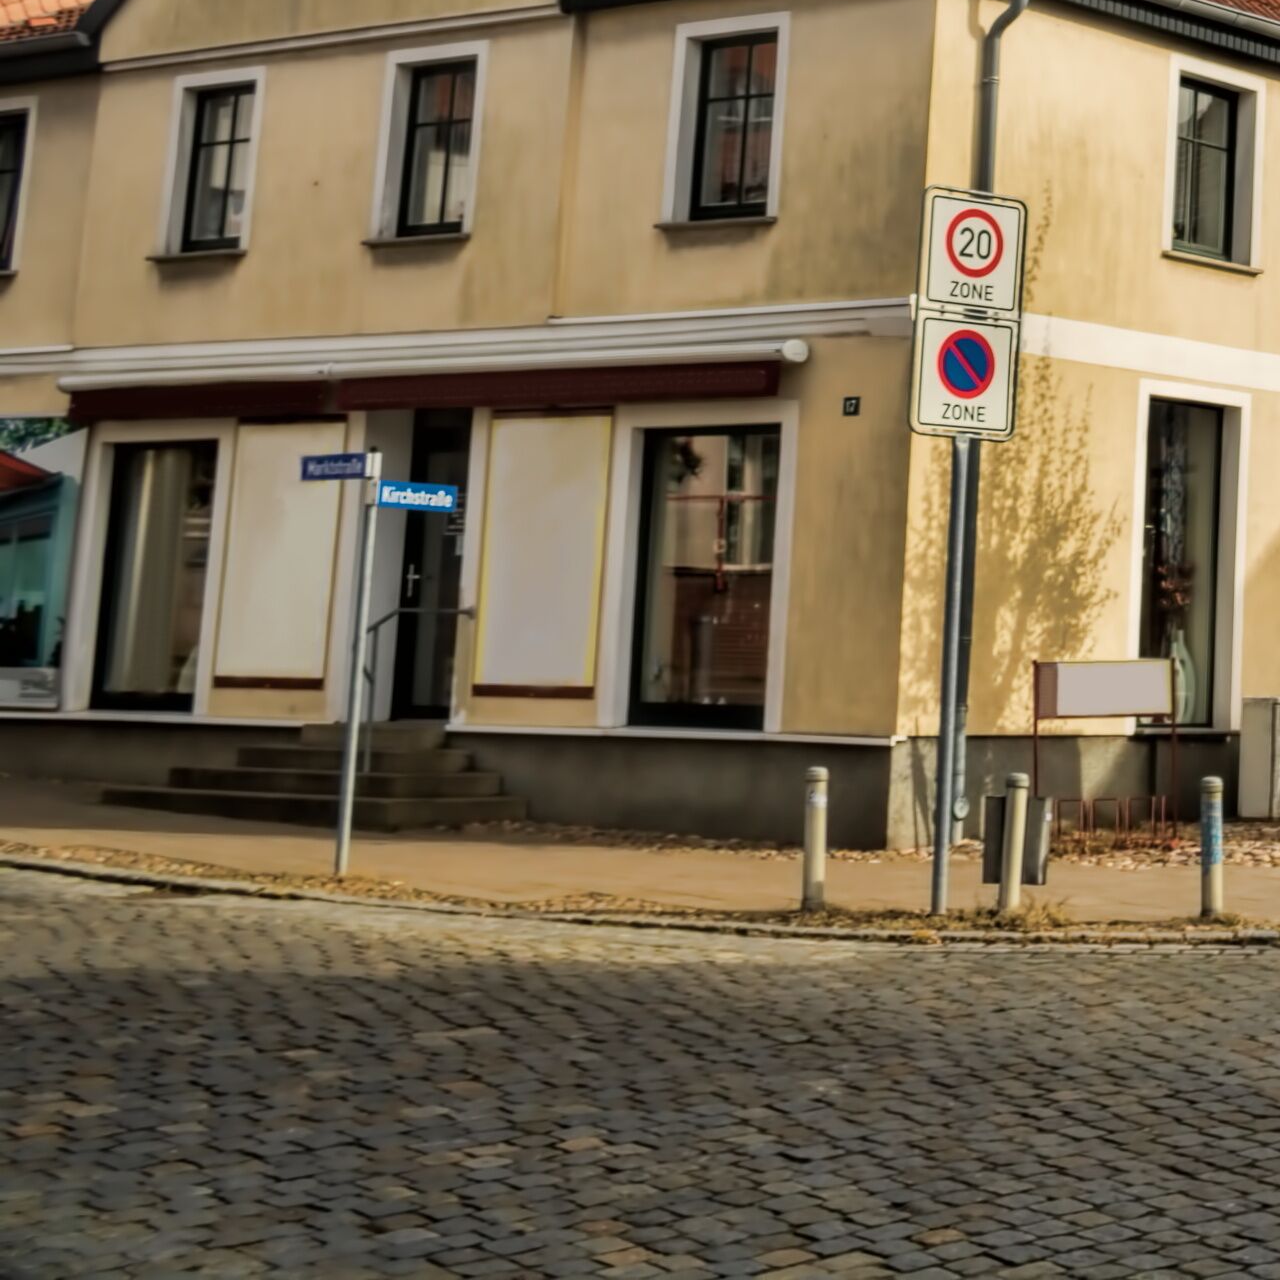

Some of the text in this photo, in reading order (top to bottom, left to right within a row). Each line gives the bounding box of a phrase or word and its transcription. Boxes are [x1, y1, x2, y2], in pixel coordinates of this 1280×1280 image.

[958, 226, 992, 260] 20
[949, 280, 994, 302] ZONE
[941, 402, 987, 423] ZONE
[381, 485, 454, 508] Kirchstraße
